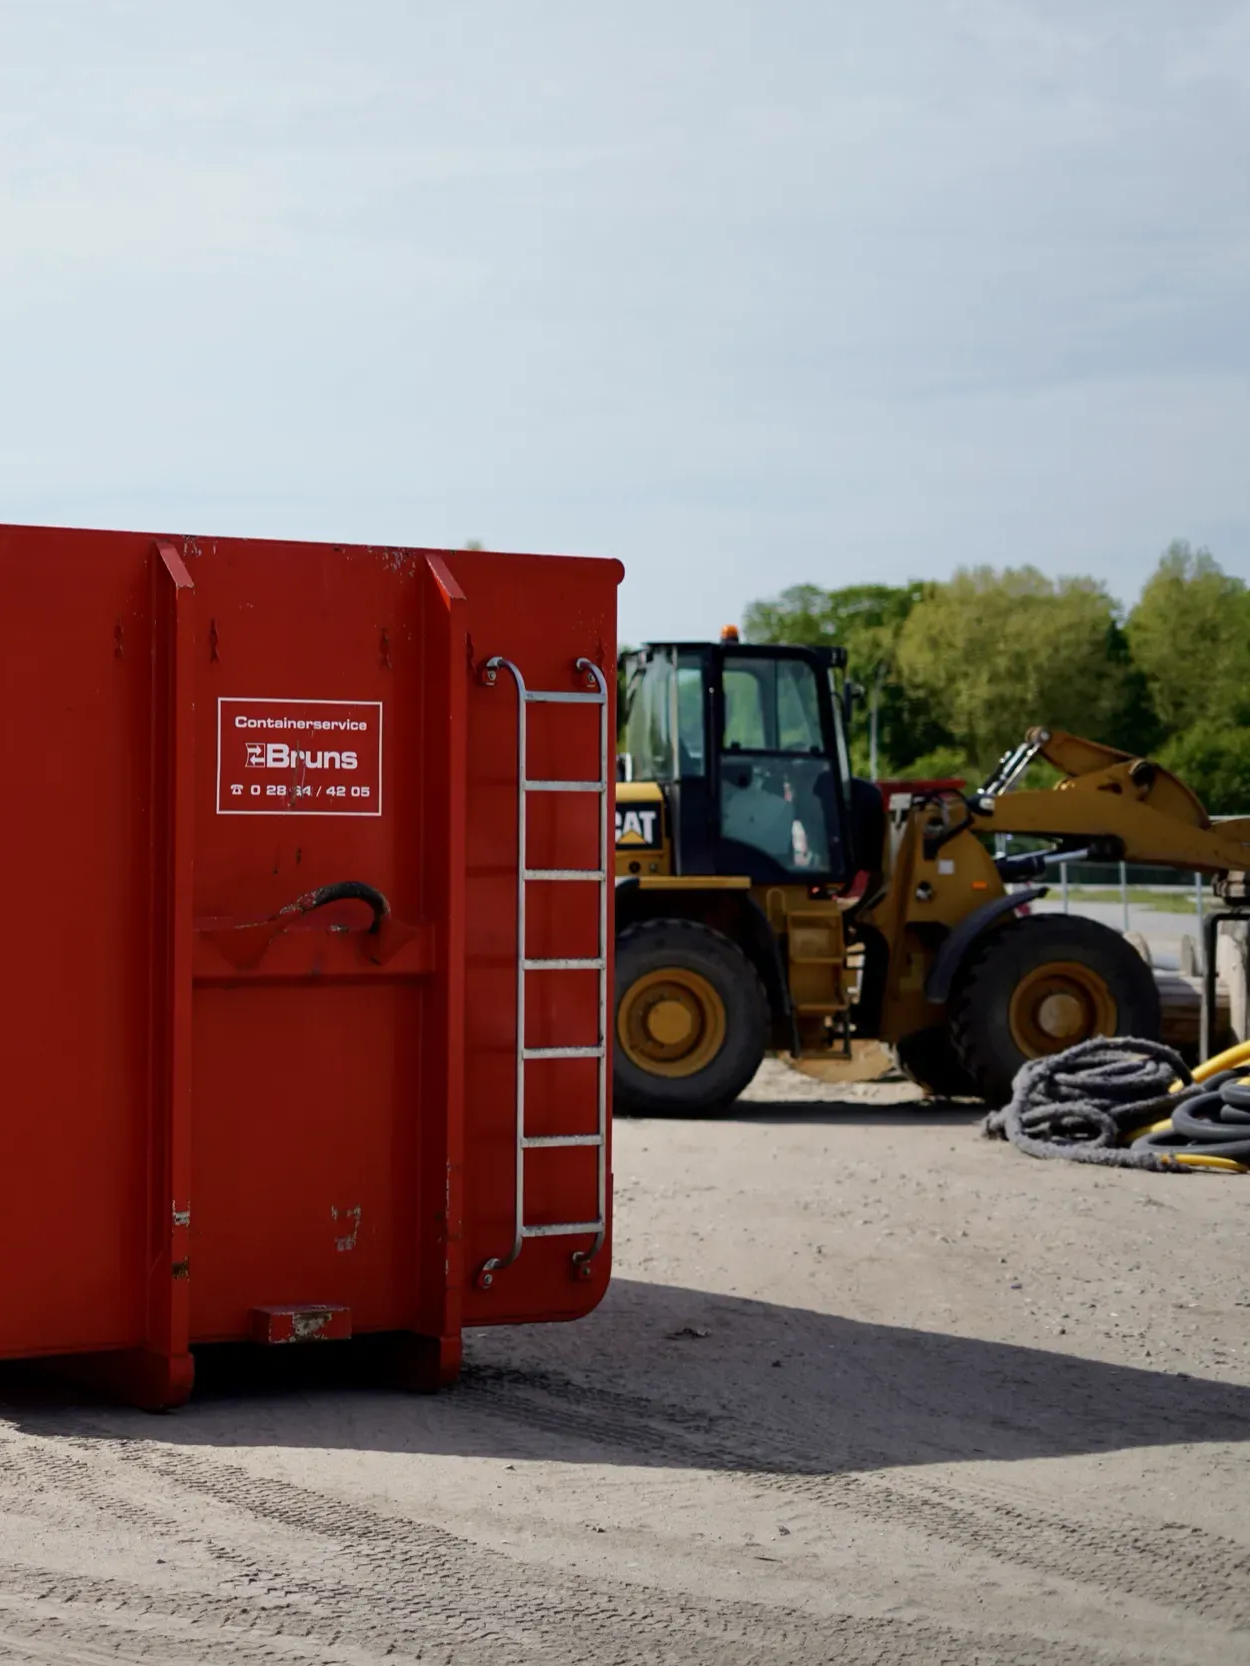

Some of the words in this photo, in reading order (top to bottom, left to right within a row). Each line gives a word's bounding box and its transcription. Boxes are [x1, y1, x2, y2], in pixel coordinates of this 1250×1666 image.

[234, 715, 368, 731] Containerservice
[266, 743, 358, 770] Bruns
[266, 784, 287, 796] 28
[325, 786, 347, 797] 42
[350, 786, 371, 798] 05
